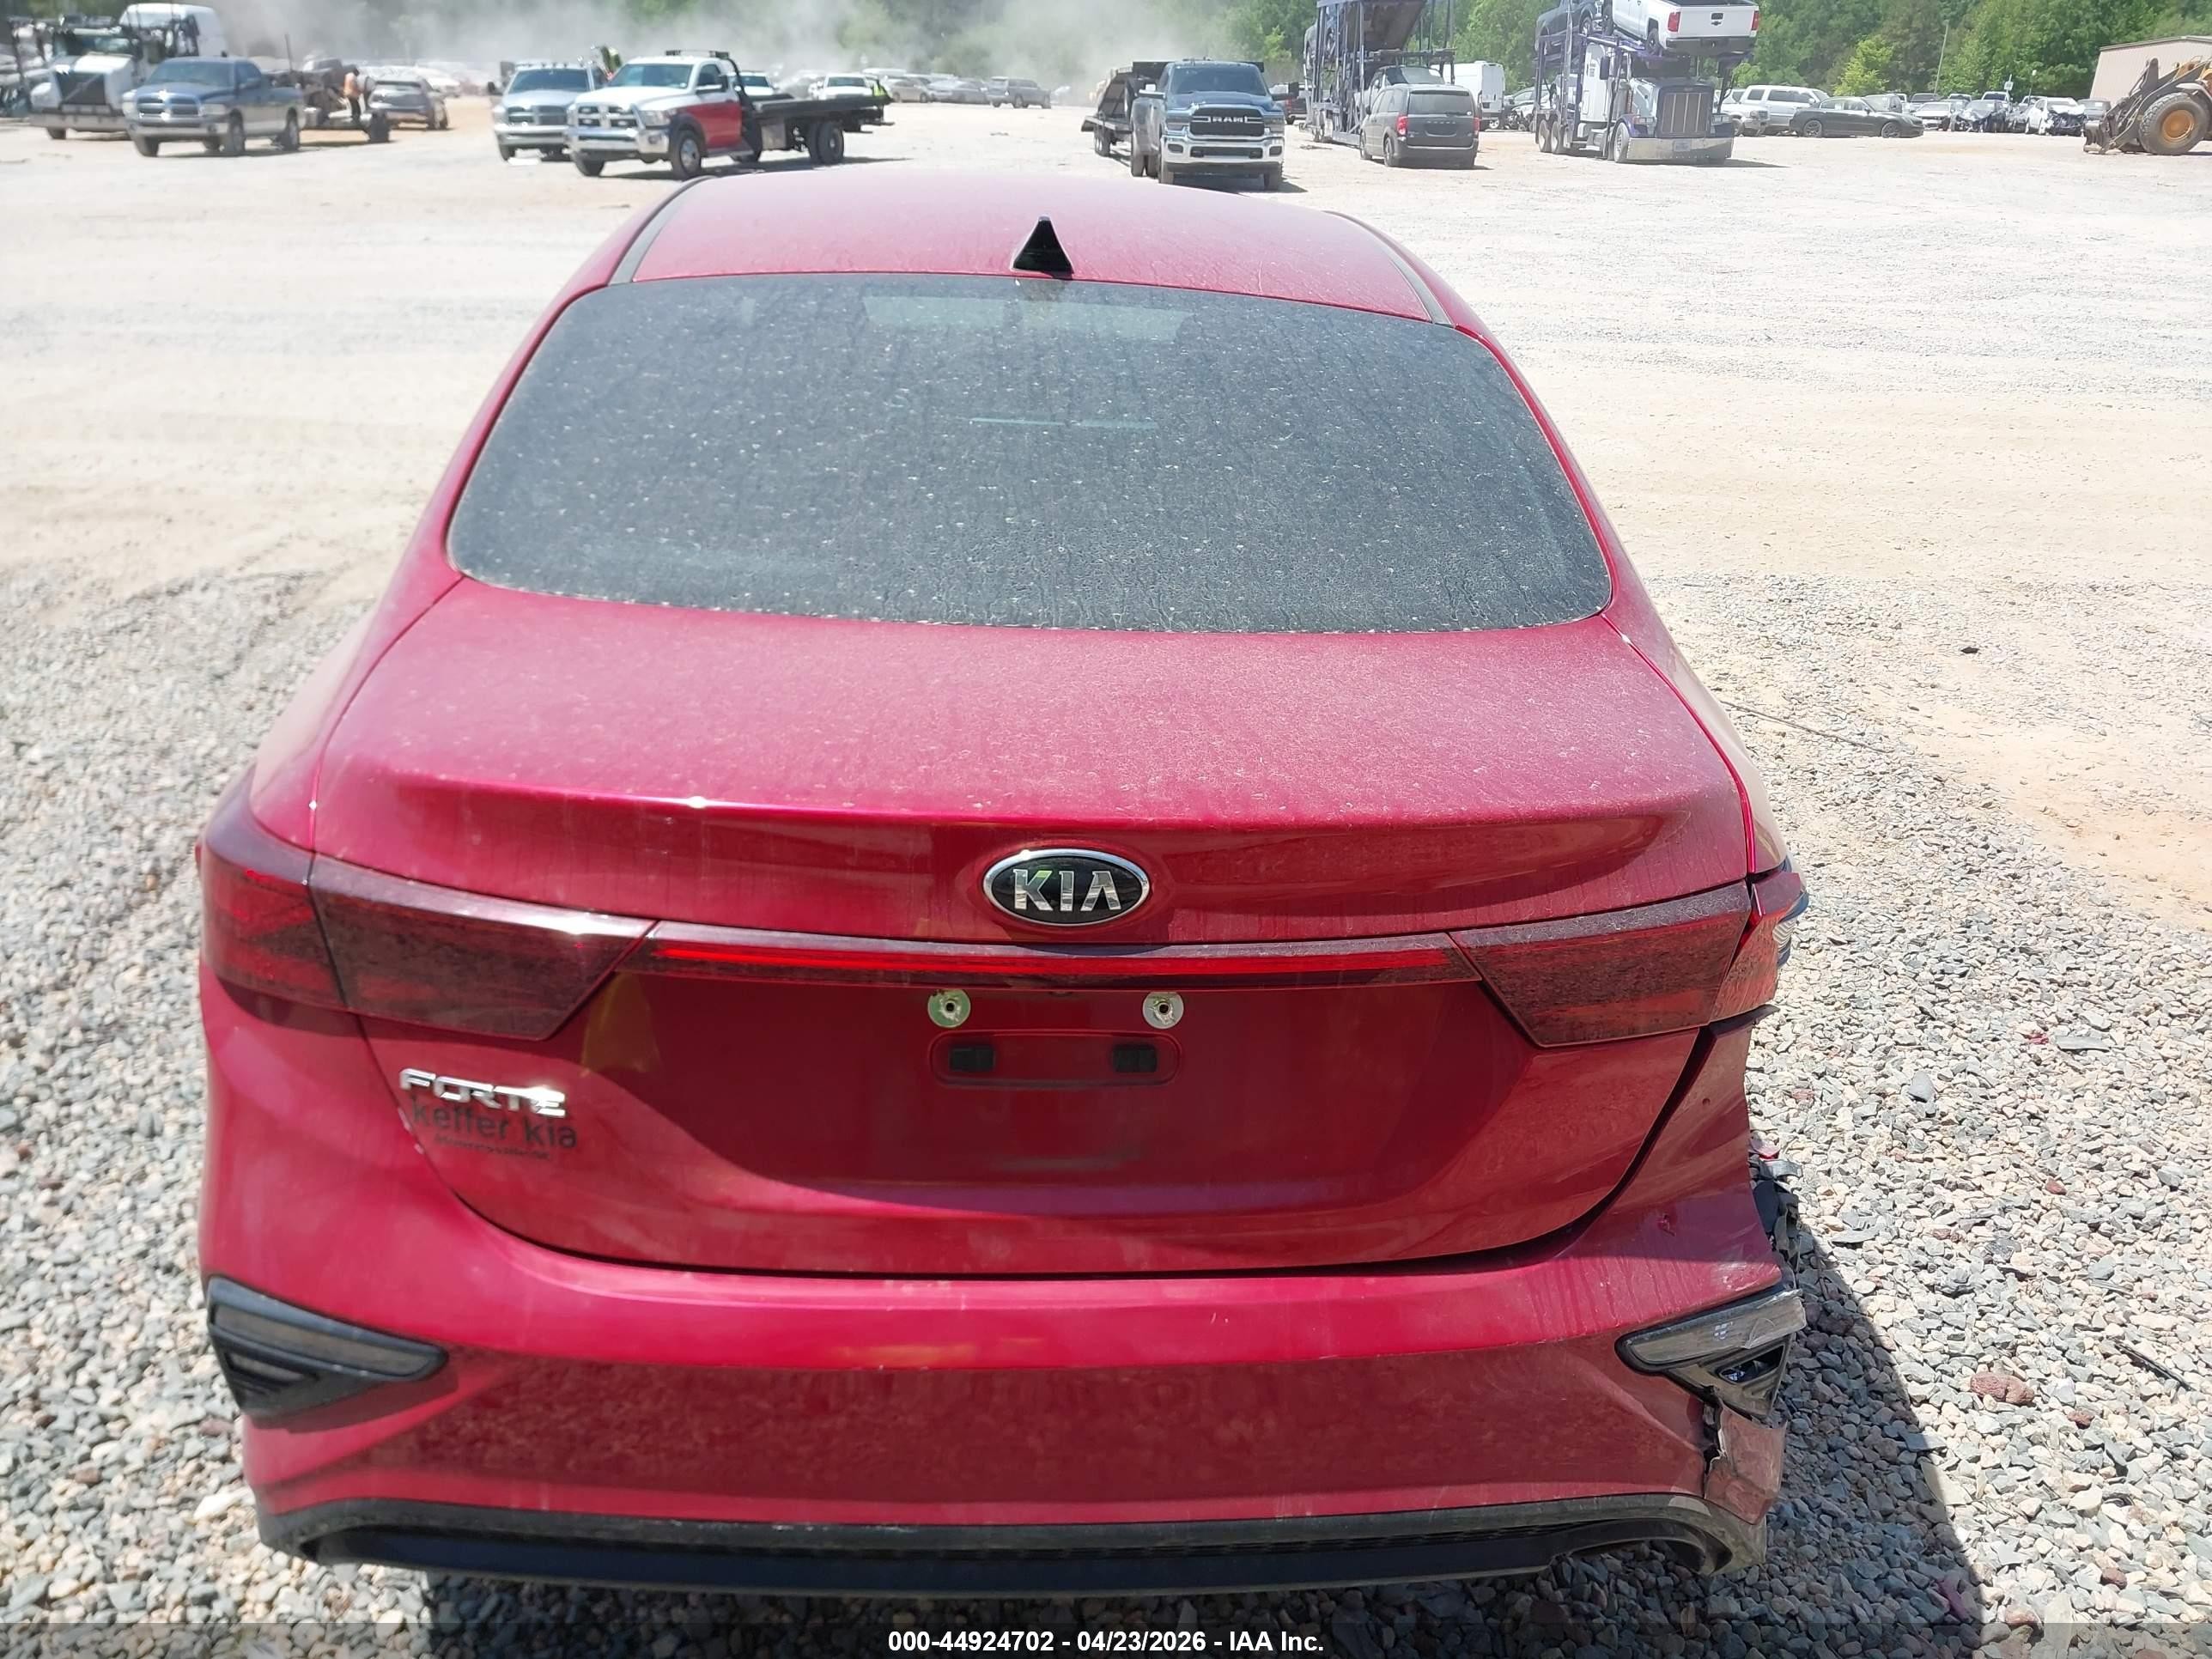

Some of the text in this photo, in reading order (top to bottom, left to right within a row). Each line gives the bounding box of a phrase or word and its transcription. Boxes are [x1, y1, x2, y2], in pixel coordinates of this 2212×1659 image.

[1012, 868, 1121, 912] KIA
[399, 1067, 566, 1118] FORTE
[523, 1115, 578, 1148] kia
